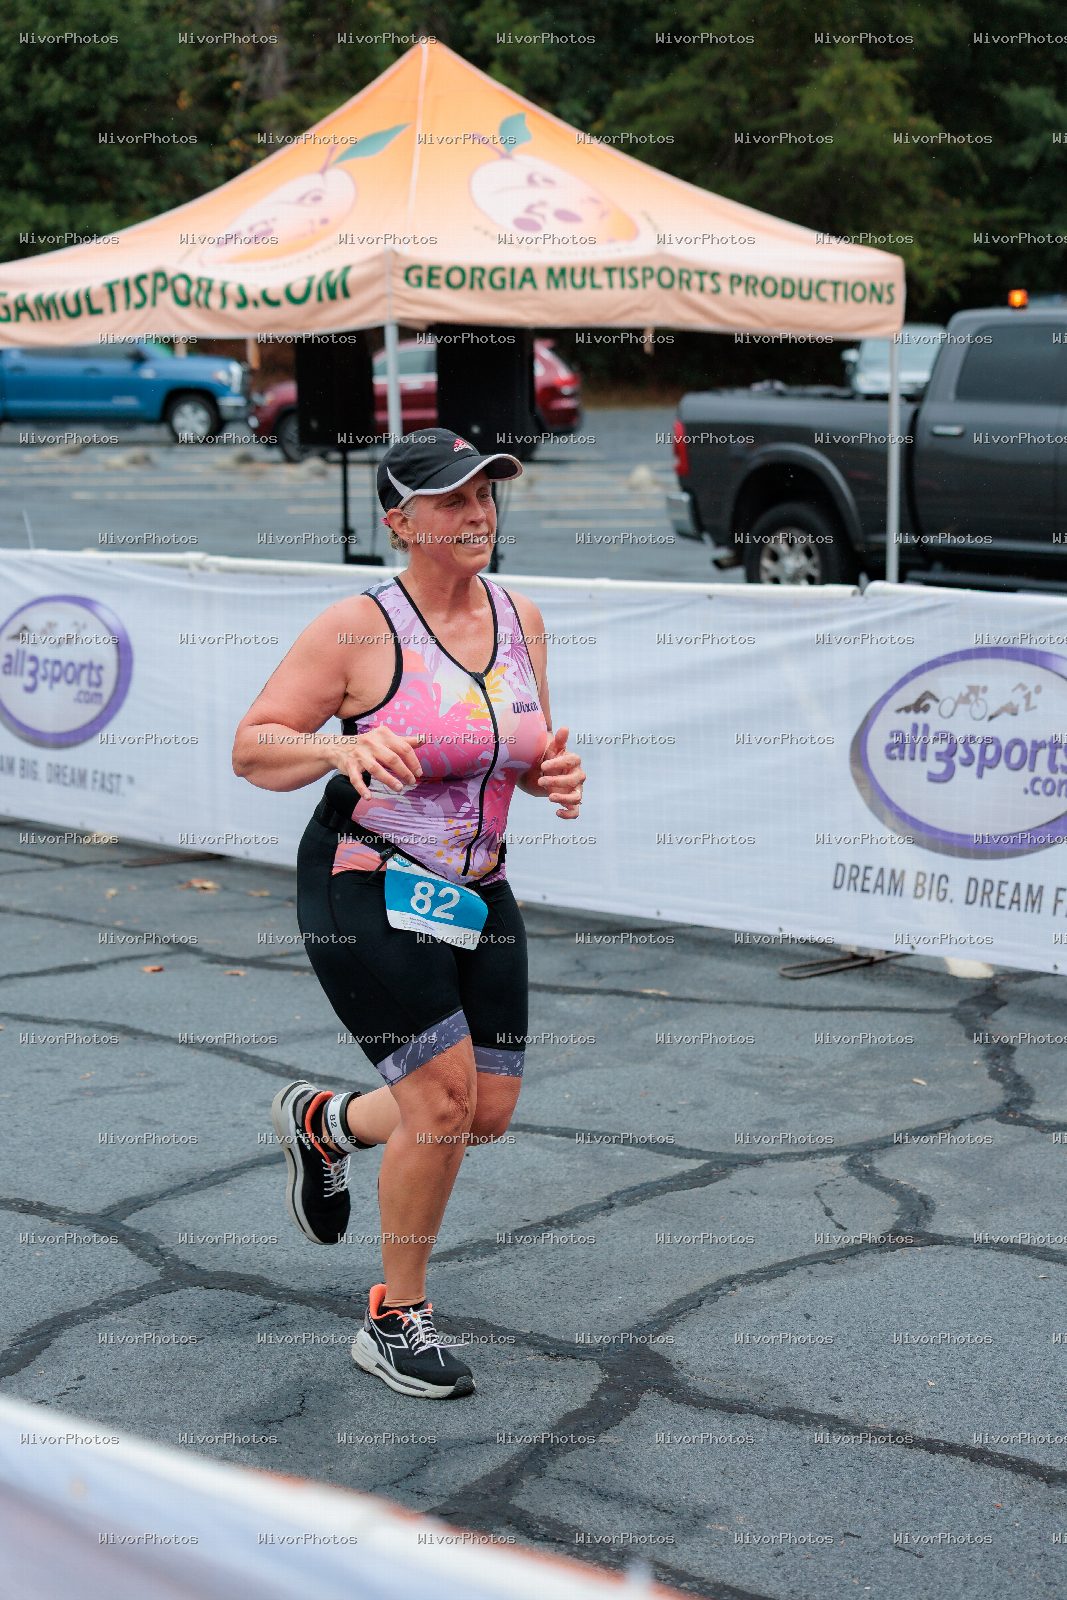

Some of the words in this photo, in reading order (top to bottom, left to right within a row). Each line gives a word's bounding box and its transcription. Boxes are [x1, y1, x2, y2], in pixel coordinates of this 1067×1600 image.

[404, 263, 537, 290] GEORGIA
[546, 265, 721, 294] MULTISPORTS
[730, 272, 895, 305] PRODUCTIONS
[2, 649, 104, 693] all3sports
[46, 761, 88, 789] DREAM
[410, 880, 461, 920] 82
[832, 862, 906, 897] DREAM
[912, 871, 954, 904] BIG.
[964, 876, 1045, 914] DREAM
